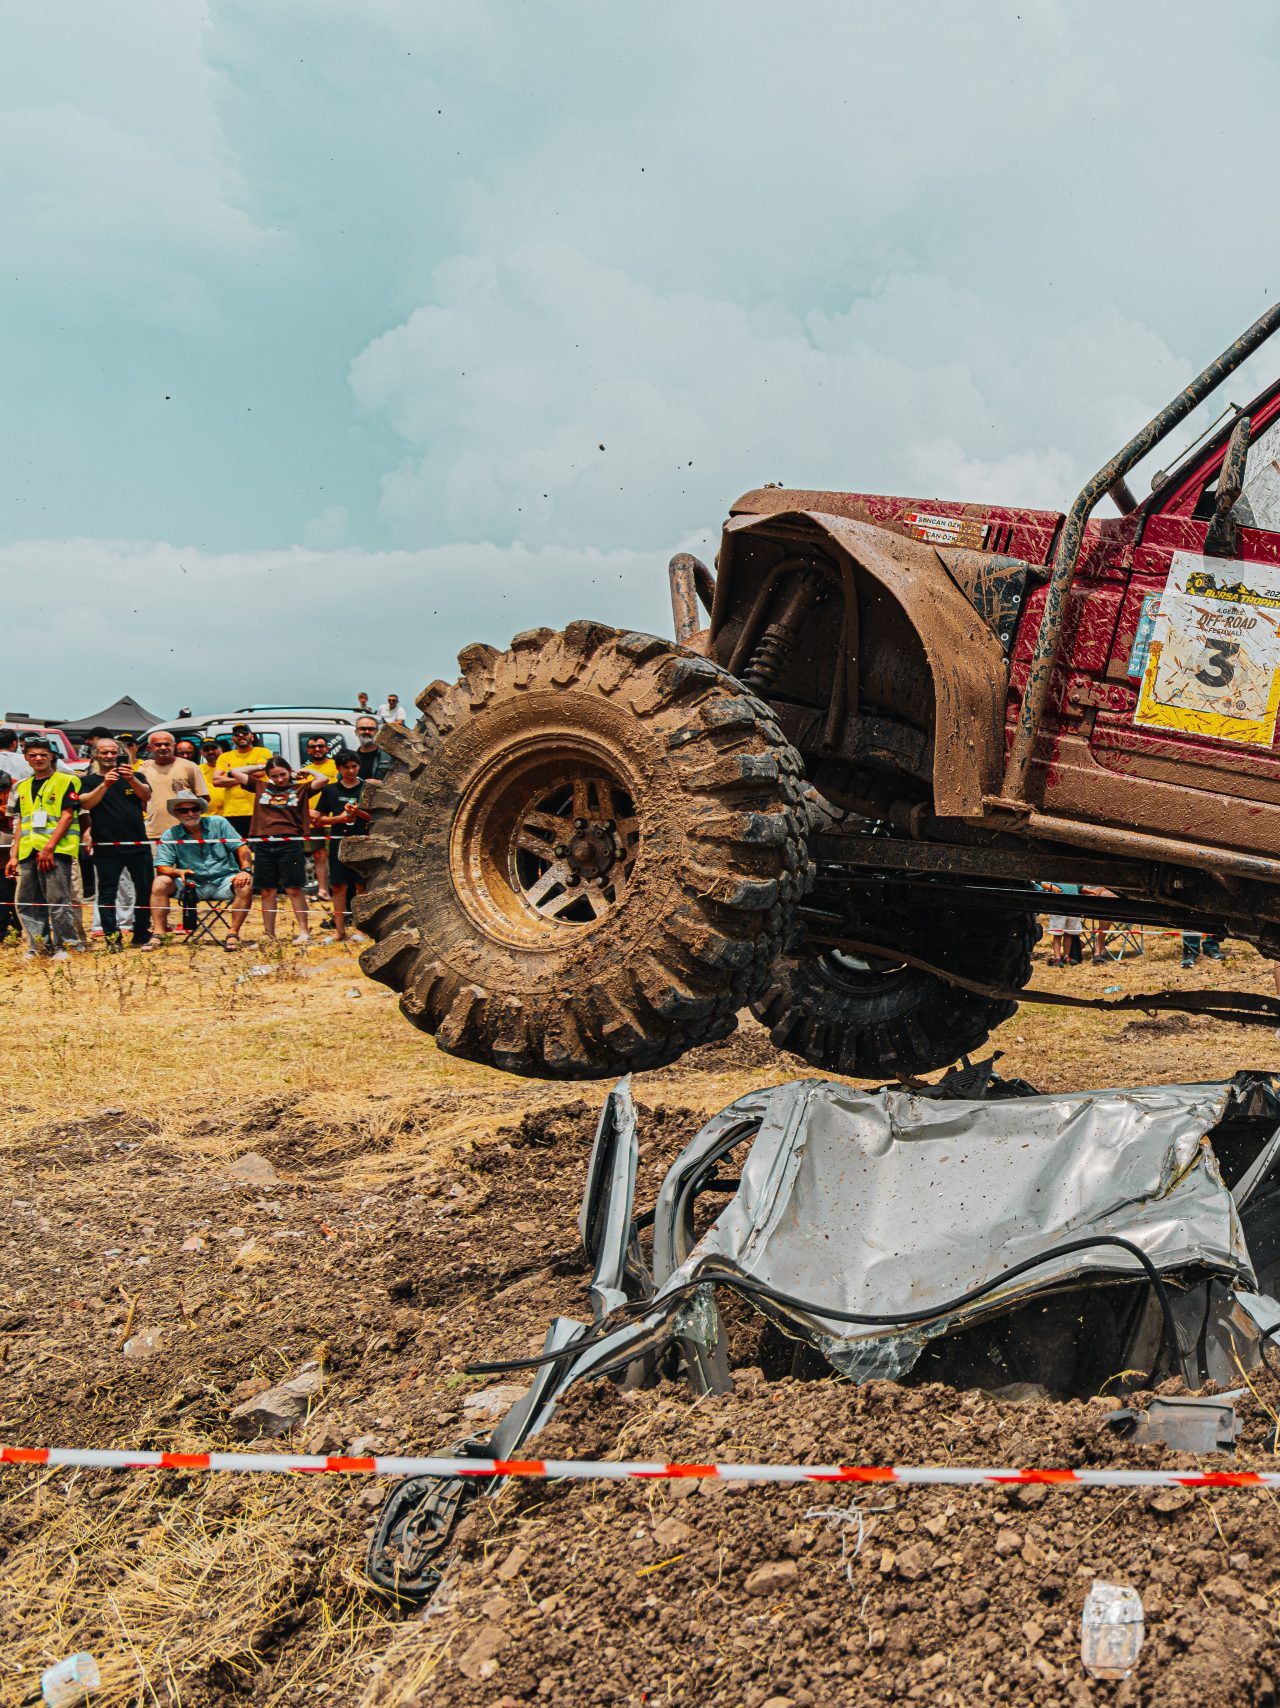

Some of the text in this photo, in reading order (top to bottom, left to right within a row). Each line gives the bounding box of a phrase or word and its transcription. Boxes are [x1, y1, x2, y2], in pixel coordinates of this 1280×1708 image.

[1204, 589, 1239, 601] BURSA
[1200, 613, 1257, 629] OFF-ROAD
[1195, 638, 1240, 688] 3
